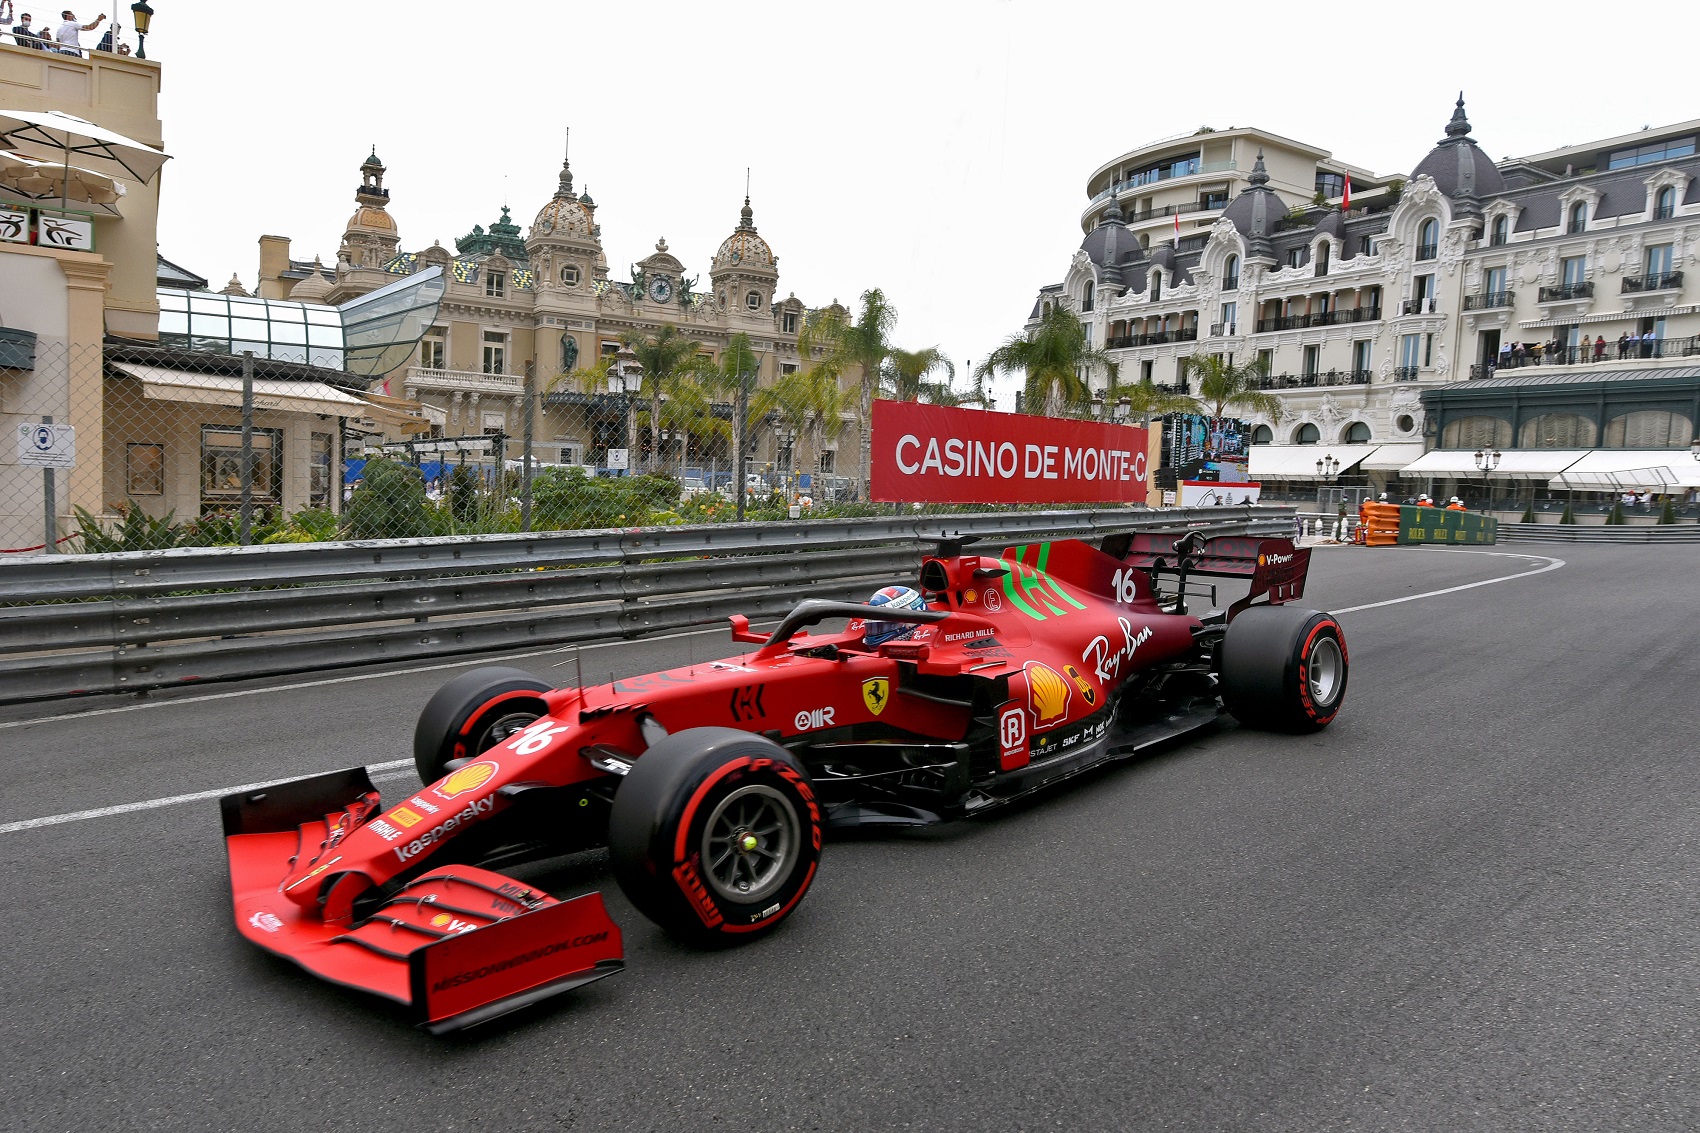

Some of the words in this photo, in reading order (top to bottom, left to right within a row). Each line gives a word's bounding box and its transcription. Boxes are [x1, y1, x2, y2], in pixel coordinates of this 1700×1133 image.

[895, 434, 1018, 479] CASINO
[1024, 444, 1058, 479] DE
[1111, 567, 1136, 604] 16
[945, 631, 974, 642] RICHARD
[976, 628, 995, 637] MILLE
[506, 720, 570, 756] 16
[1062, 733, 1080, 747] SKF
[409, 795, 442, 815] kaspersky
[748, 758, 774, 772] P
[777, 766, 821, 850] ZERO
[367, 819, 403, 841] MAHLE
[393, 793, 495, 863] kaspersky
[672, 860, 724, 929] PIRELLI
